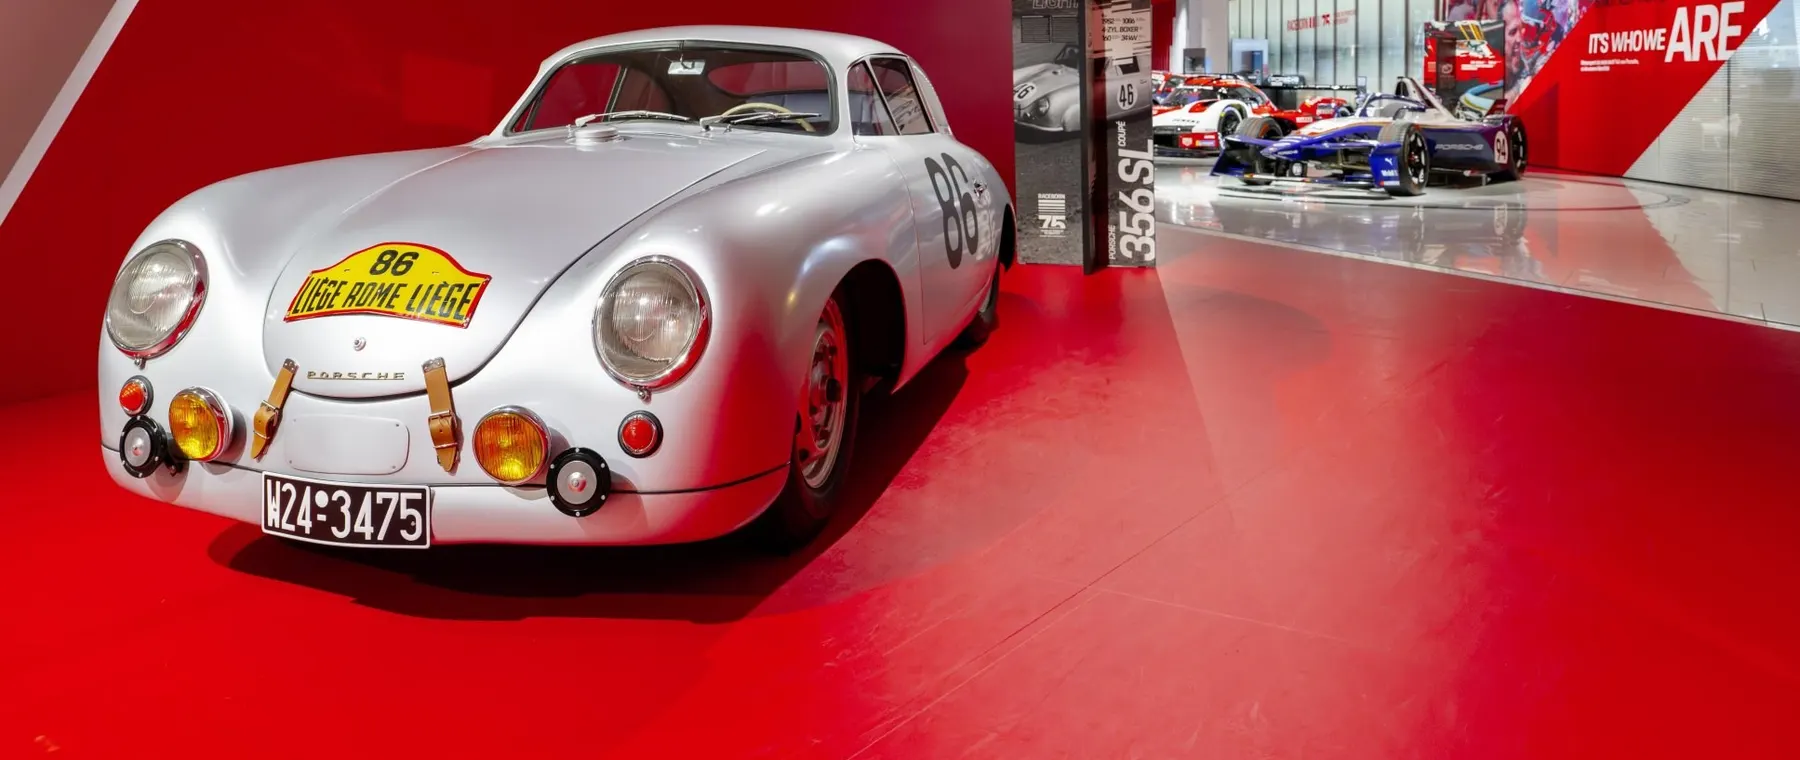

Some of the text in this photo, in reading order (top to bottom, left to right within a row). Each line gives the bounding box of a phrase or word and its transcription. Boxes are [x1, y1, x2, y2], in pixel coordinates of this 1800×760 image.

[1611, 29, 1643, 53] WHO
[1643, 28, 1667, 51] WE
[1664, 1, 1745, 63] ARE
[1119, 83, 1134, 106] 46
[1116, 121, 1126, 147] COUPÉ
[1434, 143, 1484, 151] PORSCHE
[1496, 138, 1506, 161] 94
[924, 152, 978, 270] 86
[1117, 139, 1155, 262] 356 SL
[1038, 215, 1066, 229] 75
[1108, 224, 1116, 260] PORSCHE
[369, 249, 420, 276] 86
[342, 281, 408, 309] ROME
[405, 280, 481, 321] LIÈGE
[306, 370, 405, 381] PORSCHE
